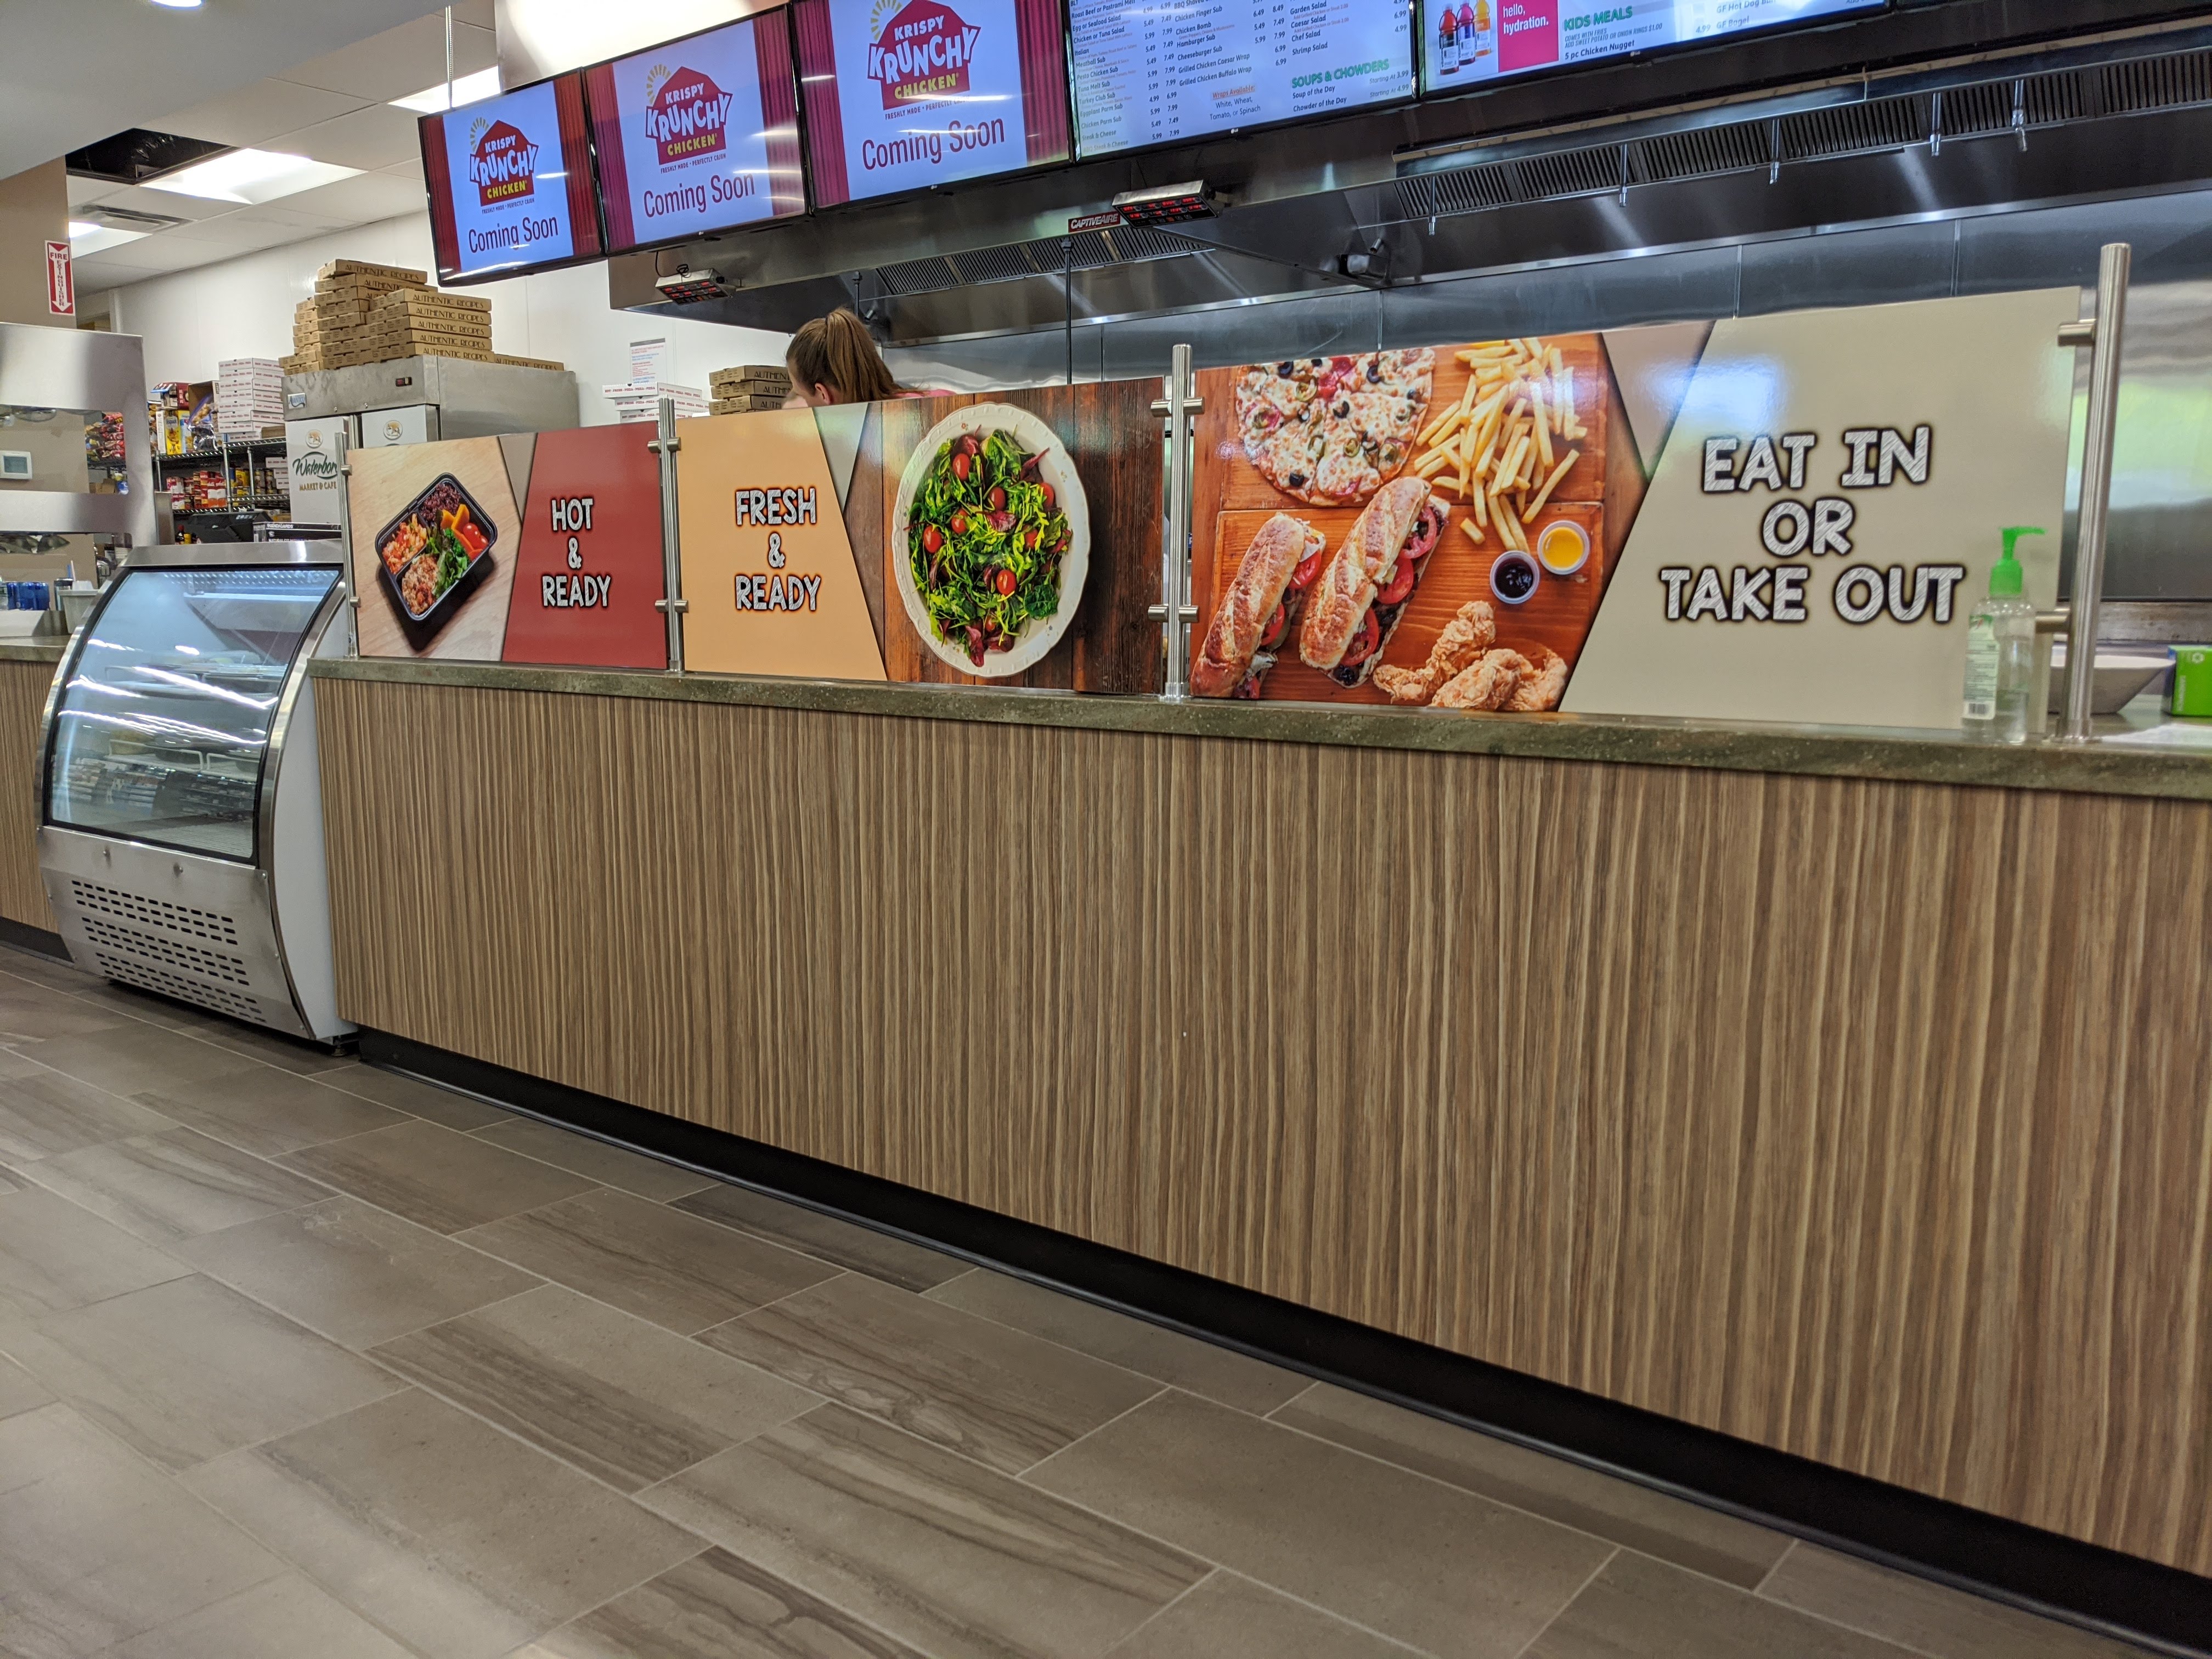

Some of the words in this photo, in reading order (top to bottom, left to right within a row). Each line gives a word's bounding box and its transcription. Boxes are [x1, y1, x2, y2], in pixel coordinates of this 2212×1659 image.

[1071, 11, 1084, 19] Roast
[1085, 7, 1096, 16] Beef
[1103, 1, 1123, 11] Pastrami
[1175, 13, 1195, 22] Chicken
[1196, 9, 1212, 18] Finger
[1253, 9, 1264, 17] 6.49
[1272, 4, 1284, 13] 8.49
[1290, 5, 1310, 15] Garden
[1311, 2, 1327, 10] Salad
[1394, 10, 1406, 19] 6.99
[1503, 3, 1526, 18] hello,
[1088, 18, 1107, 27] Seafood
[1108, 14, 1121, 22] Salad
[1144, 19, 1154, 27] 5.49
[1161, 15, 1172, 23] 7.49
[1254, 22, 1265, 31] 5.49
[1273, 18, 1284, 26] 7.49
[1291, 20, 1309, 29] Caesar
[1311, 15, 1326, 24] Salad
[1503, 15, 1549, 36] hydration.
[1564, 15, 1590, 31] KIDS
[1593, 5, 1633, 25] MEALS
[894, 15, 944, 41] KRISPY
[1163, 27, 1172, 36] 7.99
[1176, 26, 1195, 35] Chicken
[1197, 21, 1211, 30] Bomb
[1395, 25, 1407, 33] 4.99
[1565, 34, 1580, 42] COMES
[1581, 31, 1593, 40] WITH
[1594, 28, 1607, 37] FRIES
[1575, 37, 1590, 47] SWEET
[1591, 33, 1608, 44] POTATO
[1618, 29, 1632, 37] ONION
[1633, 26, 1647, 35] RINGS
[1649, 23, 1662, 32] $1.00
[1177, 37, 1205, 48] Hamburger
[1206, 33, 1215, 42] Sub
[1255, 36, 1266, 44] 5.99
[1274, 31, 1285, 40] 7.99
[1291, 33, 1305, 42] Chef
[1305, 30, 1321, 38] Salad
[1163, 41, 1173, 49] 7.49
[1275, 44, 1286, 53] 6.99
[1292, 46, 1311, 55] Shrimp
[1312, 42, 1328, 50] Salad
[1571, 52, 1579, 60] pc
[1581, 45, 1608, 56] Chicken
[1609, 40, 1634, 51] Nugget
[869, 27, 978, 84] KRUNCHY
[1177, 49, 1212, 61] Cheeseburger
[1276, 58, 1286, 66] 6.99
[1178, 64, 1195, 74] Grilled
[1196, 60, 1216, 70] Chicken
[1217, 57, 1234, 65] Caesar
[1236, 53, 1250, 61] Wrap
[1180, 77, 1196, 86] Grilled
[1197, 74, 1217, 83] Chicken
[1218, 70, 1237, 78] Buffalo
[1292, 72, 1322, 88] SOUPS
[1324, 71, 1331, 81] &
[1334, 59, 1389, 80] CHOWDERS
[895, 74, 956, 99] CHICKEN
[1166, 78, 1176, 87] 7.99
[665, 83, 704, 105] KRISPY
[1293, 91, 1306, 99] Soup
[885, 110, 906, 120] FRESHLY
[907, 106, 921, 115] MADE
[926, 100, 952, 111] PERFECTLY
[1210, 111, 1231, 120] Tomato,
[1239, 104, 1261, 116] Spinach
[1293, 102, 1317, 112] Chowder
[647, 93, 730, 143] KRUNCHY
[1169, 116, 1178, 125] 7.49
[1170, 129, 1180, 137] 7.99
[485, 135, 516, 153] KRISPY
[667, 134, 716, 156] CHICKEN
[862, 131, 942, 170] Coming
[949, 118, 1005, 153] Soon
[471, 144, 537, 187] KRUNCHY
[487, 180, 526, 199] CHICKEN
[644, 182, 707, 218] Coming
[710, 173, 755, 203] Soon
[1071, 213, 1119, 229] CAPTIVEAIRE
[469, 223, 520, 253] Coming
[522, 217, 558, 242] Soon
[50, 252, 67, 260] FIRE
[345, 264, 387, 278] AUTHENTIC
[391, 271, 419, 280] RECIPES
[413, 294, 454, 305] AUTHENTIC
[457, 300, 483, 309] RECIPES
[416, 308, 456, 319] AUTHENTIC
[458, 313, 484, 323] RECIPES
[418, 321, 456, 332] AUTHENTIC
[459, 326, 484, 336] RECIPES
[420, 335, 458, 346] AUTHENTIC
[460, 339, 485, 348] RECIPES
[423, 347, 461, 358] AUTHENTIC
[464, 352, 488, 362] RECIPES
[1703, 434, 1815, 492] EAT
[1841, 426, 1930, 486] IN
[300, 482, 318, 491] MARKET
[324, 481, 337, 489] CAFE
[735, 487, 816, 526] FRESH
[551, 497, 594, 532] HOT
[1762, 498, 1854, 556] OR
[567, 537, 583, 569] &
[768, 532, 786, 568] &
[541, 574, 612, 608] READY
[735, 575, 821, 611] READY
[1660, 566, 1809, 620] TAKE
[1835, 566, 1964, 623] OUT
